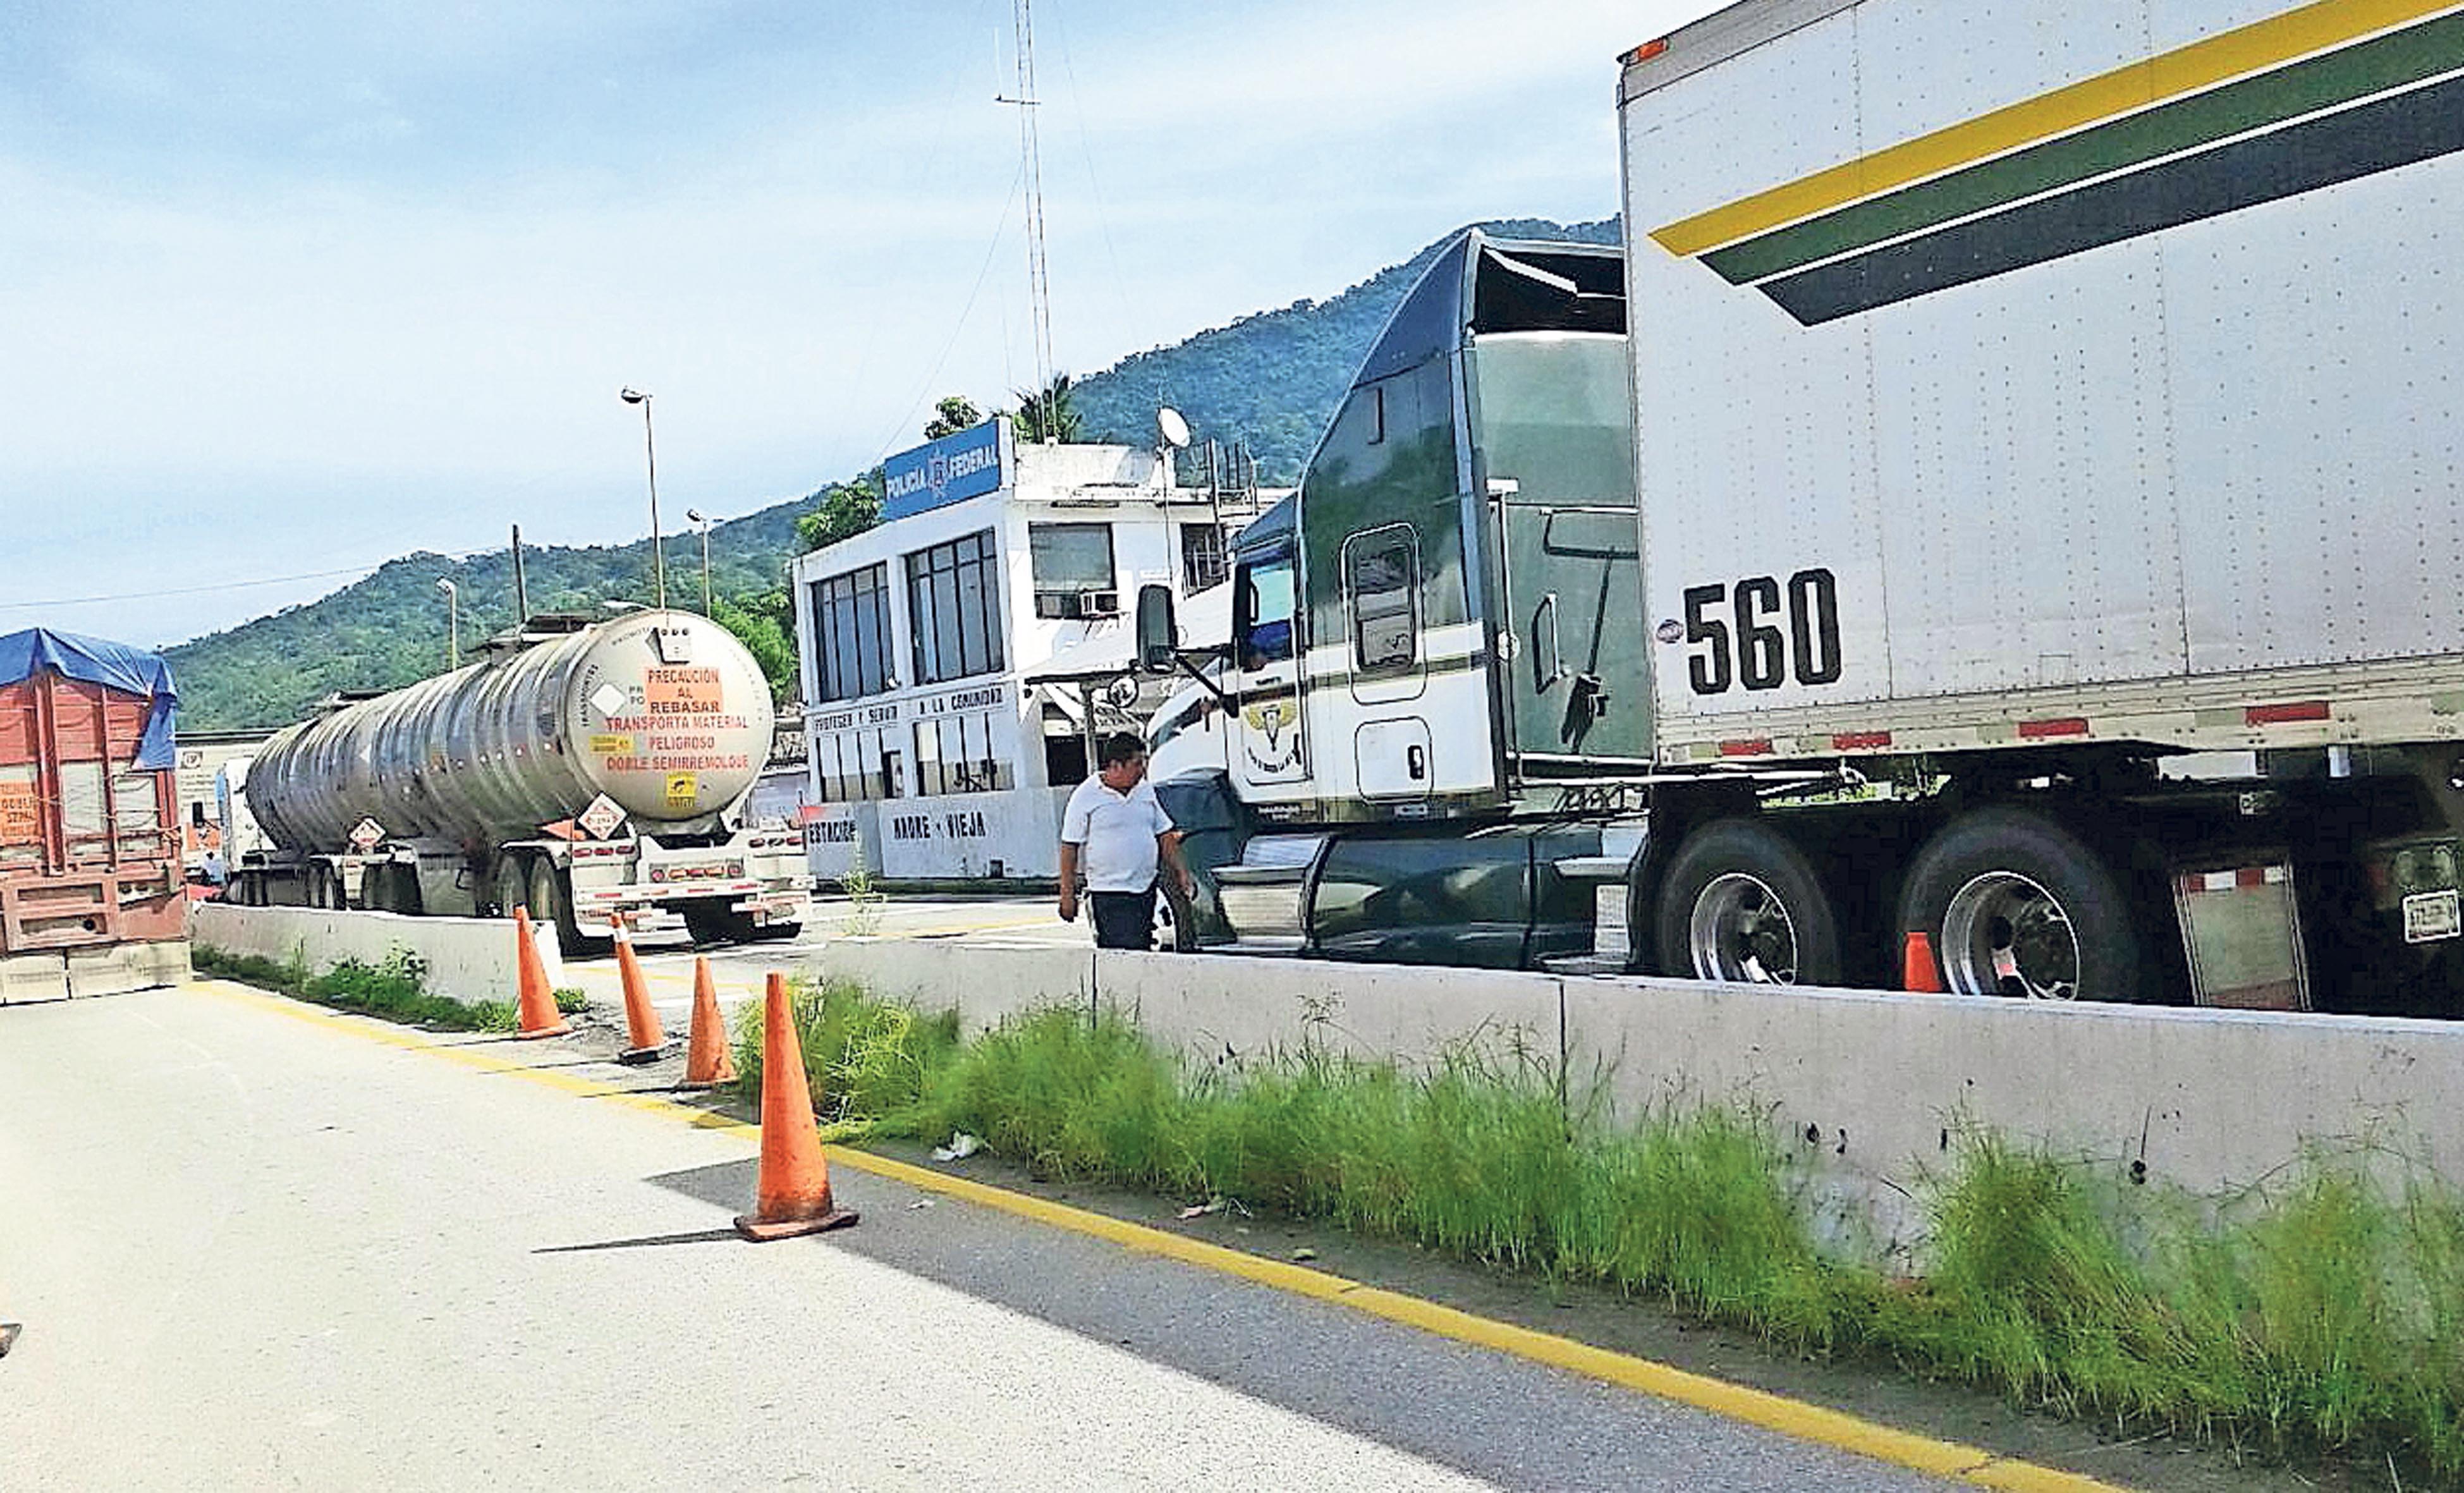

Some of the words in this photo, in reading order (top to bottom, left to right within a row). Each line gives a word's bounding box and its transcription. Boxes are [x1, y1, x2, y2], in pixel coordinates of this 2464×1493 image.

[948, 444, 998, 479] FEDERAL
[1683, 568, 1841, 695] 560
[678, 686, 693, 699] AL
[650, 701, 721, 714] REBASAR
[932, 697, 945, 713] LA
[605, 715, 690, 731] TRANSPORTA
[694, 715, 749, 729] MATERIAL
[649, 734, 716, 750] PELIGROSO
[946, 811, 987, 839] VIEJA
